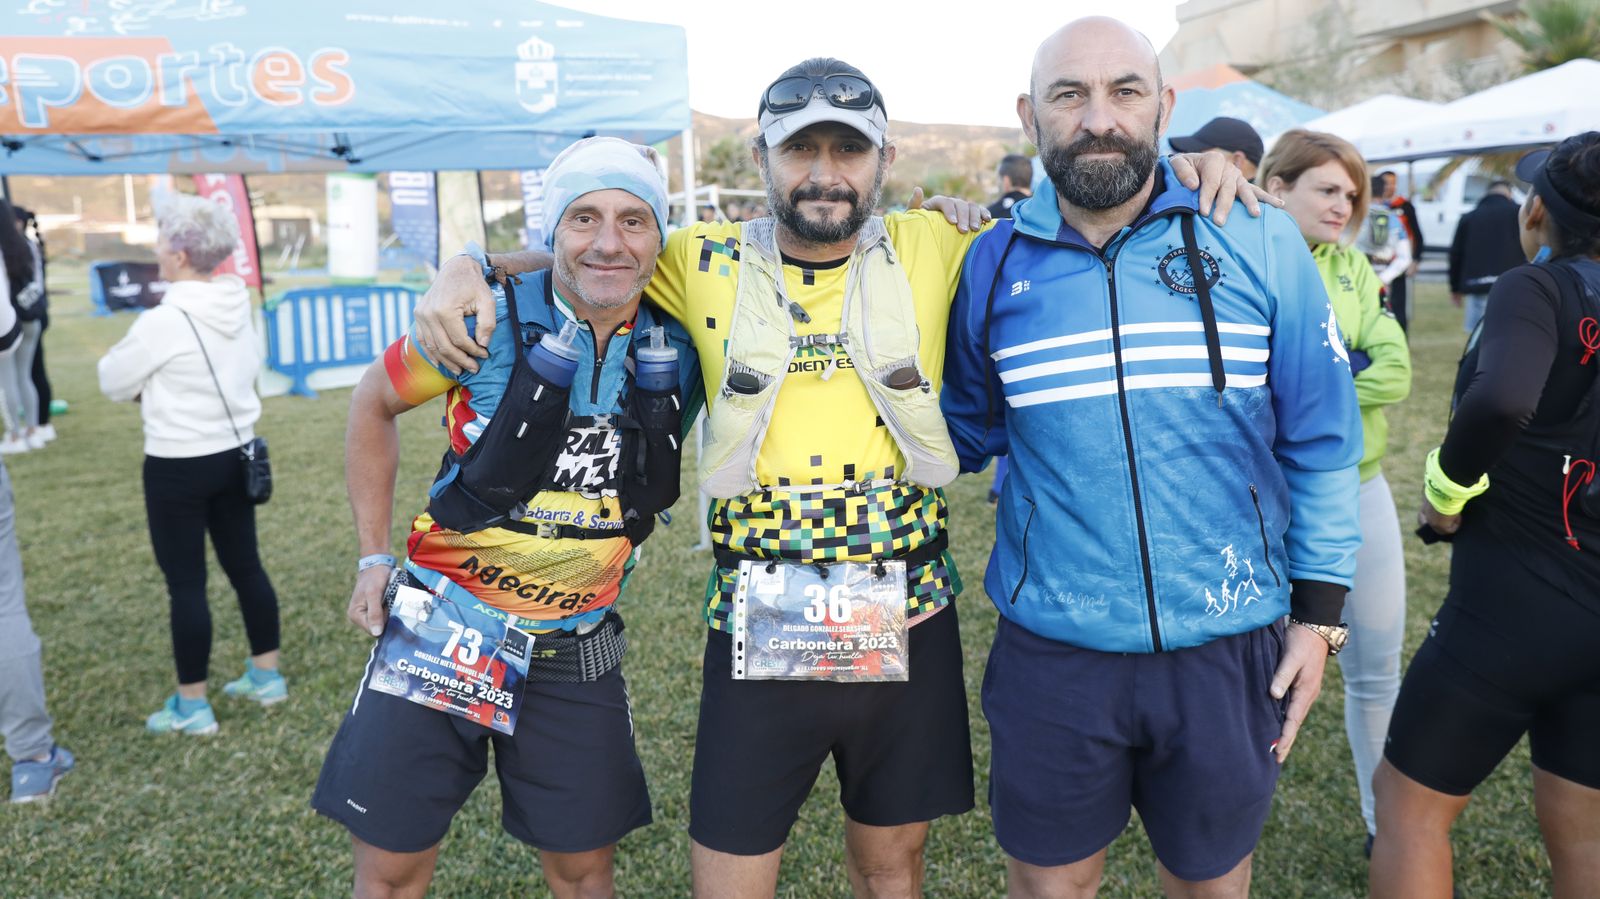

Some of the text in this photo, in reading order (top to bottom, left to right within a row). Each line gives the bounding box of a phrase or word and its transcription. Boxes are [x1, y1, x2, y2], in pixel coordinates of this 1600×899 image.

[0, 42, 356, 128] portes
[803, 584, 852, 623] 36
[441, 620, 483, 666] 73
[768, 636, 898, 651] Carbonera 2023
[396, 658, 474, 695] Carbonera
[476, 686, 514, 709] 2023
